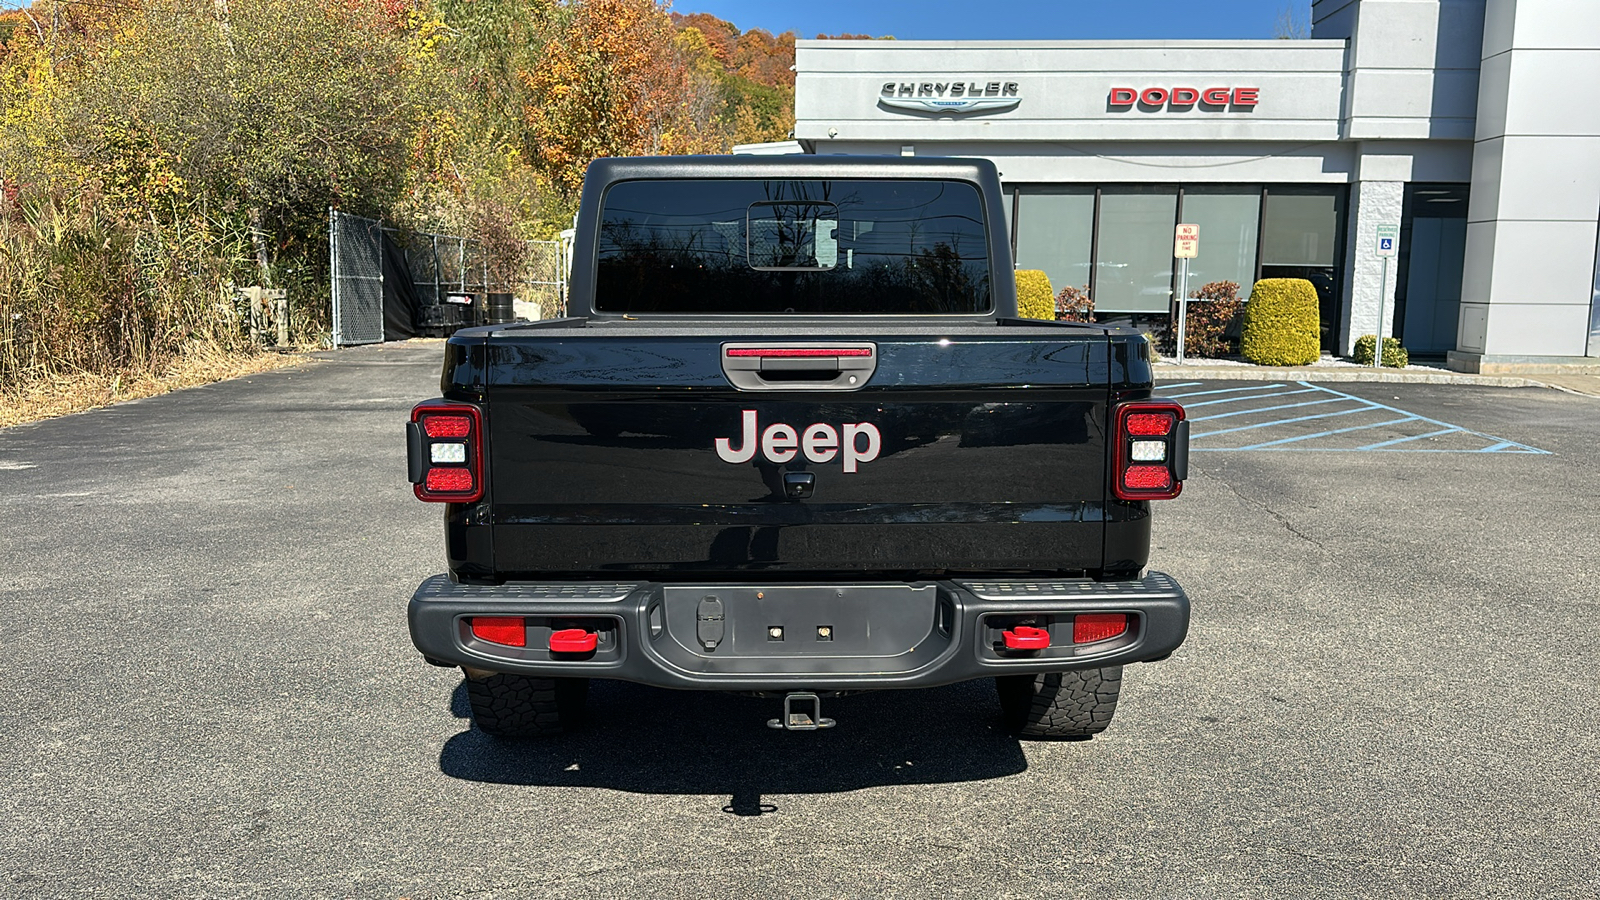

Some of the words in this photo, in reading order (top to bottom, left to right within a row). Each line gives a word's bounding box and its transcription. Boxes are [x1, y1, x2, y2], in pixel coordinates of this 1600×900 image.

[881, 81, 1019, 96] CHRYSLER
[1109, 87, 1260, 106] DODGE
[715, 409, 881, 473] Jeep
